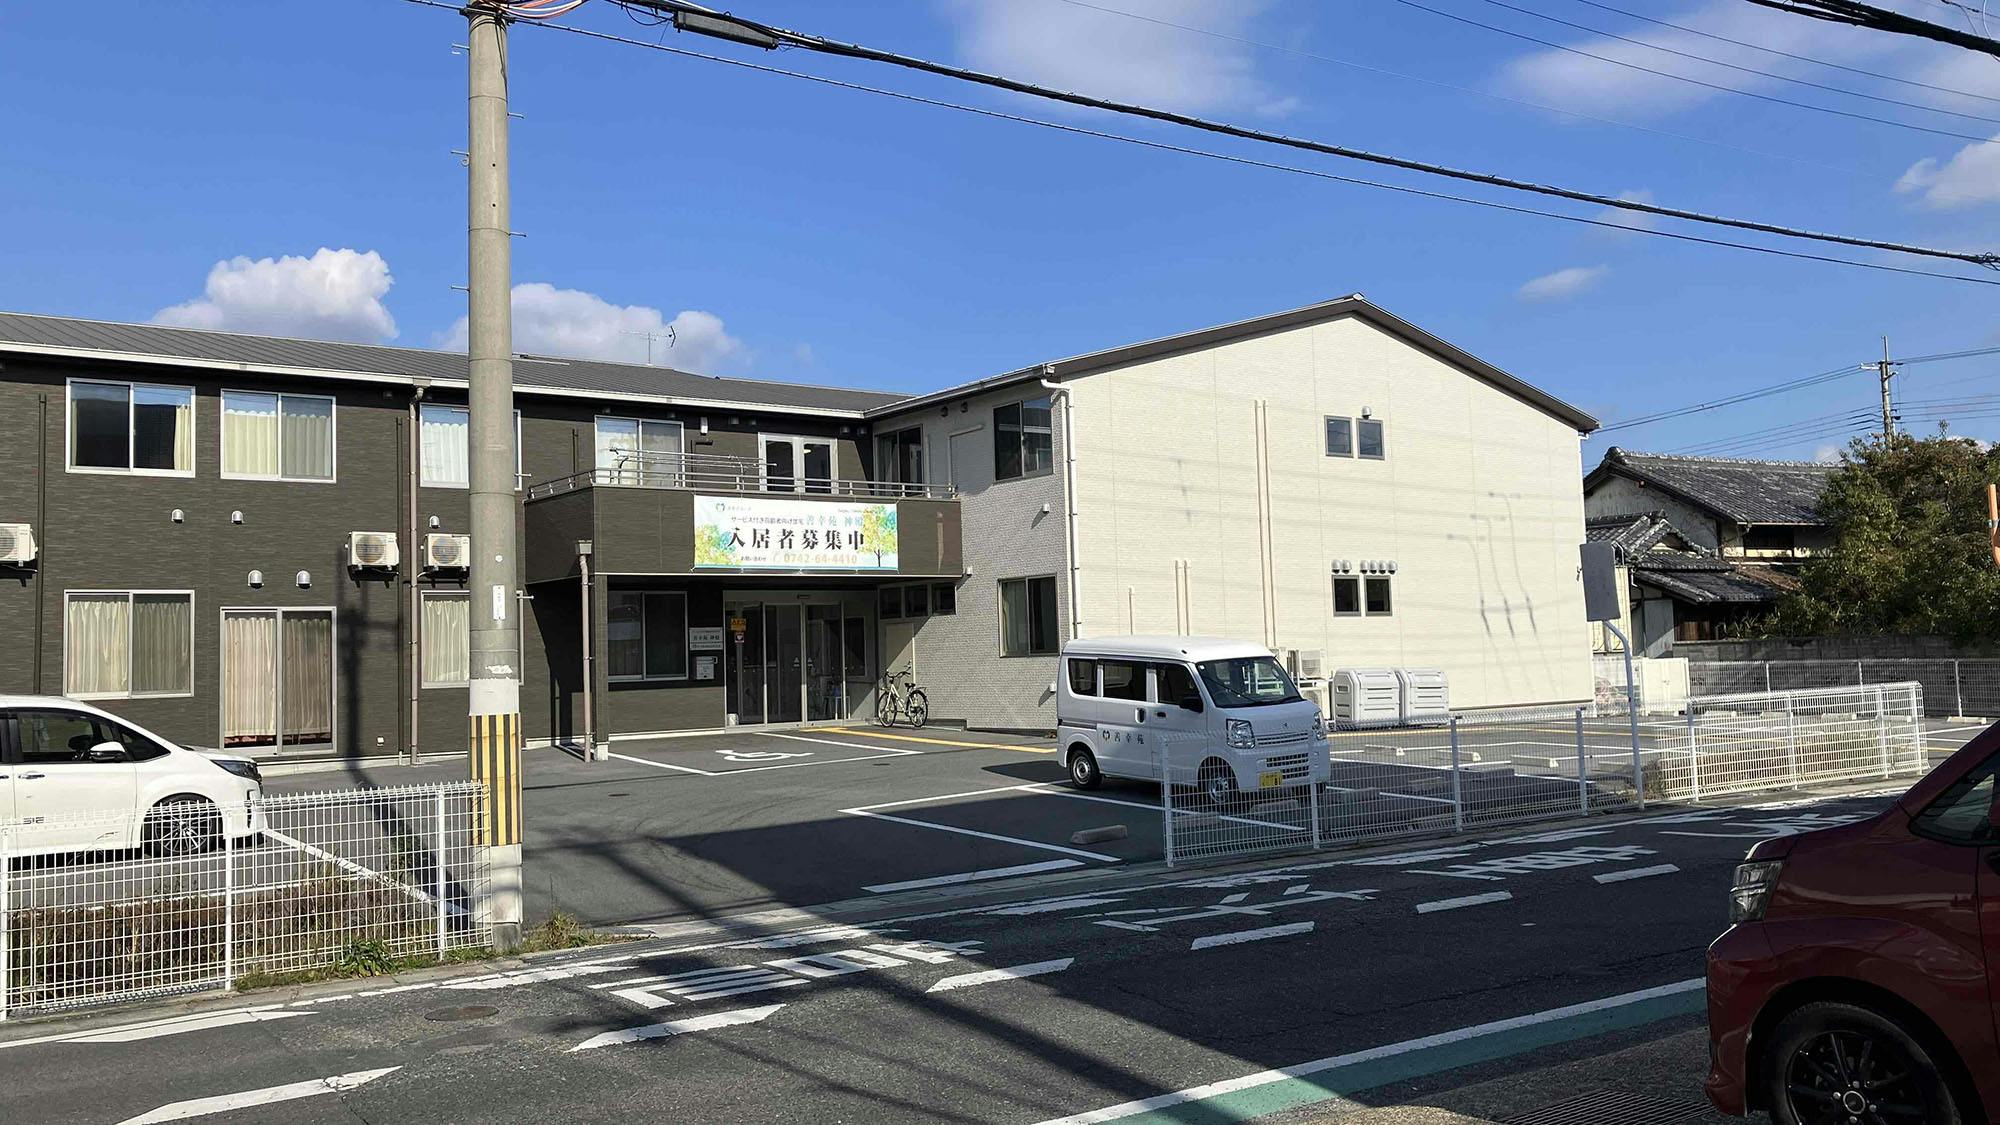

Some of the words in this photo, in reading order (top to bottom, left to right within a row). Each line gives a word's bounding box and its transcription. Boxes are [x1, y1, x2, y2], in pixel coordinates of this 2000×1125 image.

[727, 526, 864, 550] 入居者募集中
[783, 553, 858, 565] 0742-64-4410
